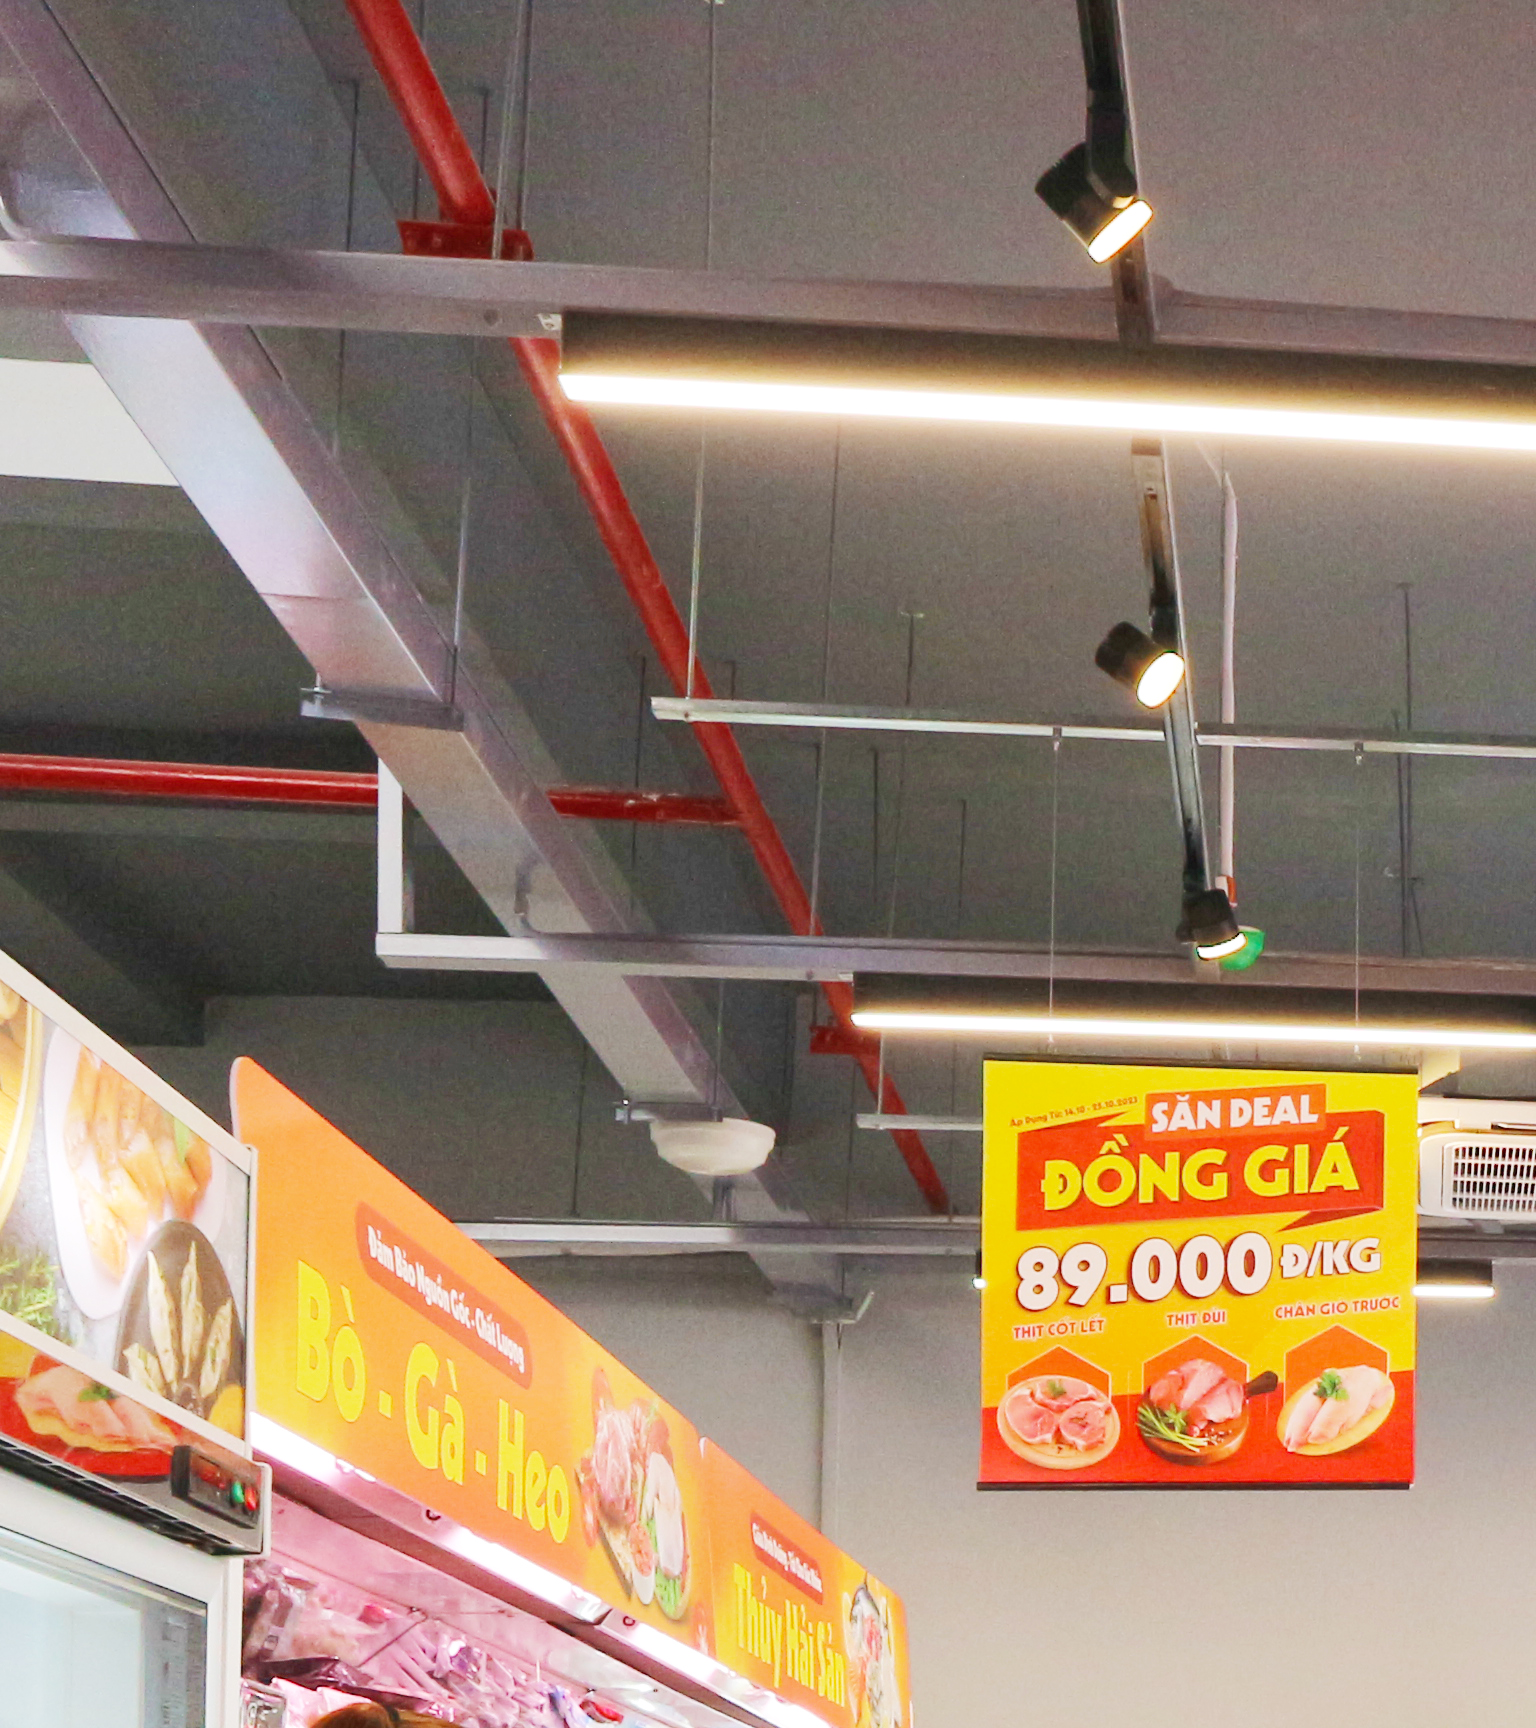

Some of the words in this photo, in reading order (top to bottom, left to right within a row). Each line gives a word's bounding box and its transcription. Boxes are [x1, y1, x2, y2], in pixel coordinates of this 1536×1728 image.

[1152, 1094, 1221, 1133] SĂN
[1230, 1094, 1319, 1128] DEAL
[1041, 1133, 1228, 1211] ĐỒNG
[1243, 1126, 1360, 1198] GIÁ
[1016, 1231, 1274, 1312] 89.000
[1279, 1237, 1382, 1280] Đ/KG
[296, 1259, 367, 1424] Bò
[404, 1340, 466, 1487] Gà
[496, 1398, 571, 1546] Heo
[733, 1562, 783, 1689] Thủy
[785, 1598, 815, 1691] Hải
[817, 1621, 845, 1708] Sản
